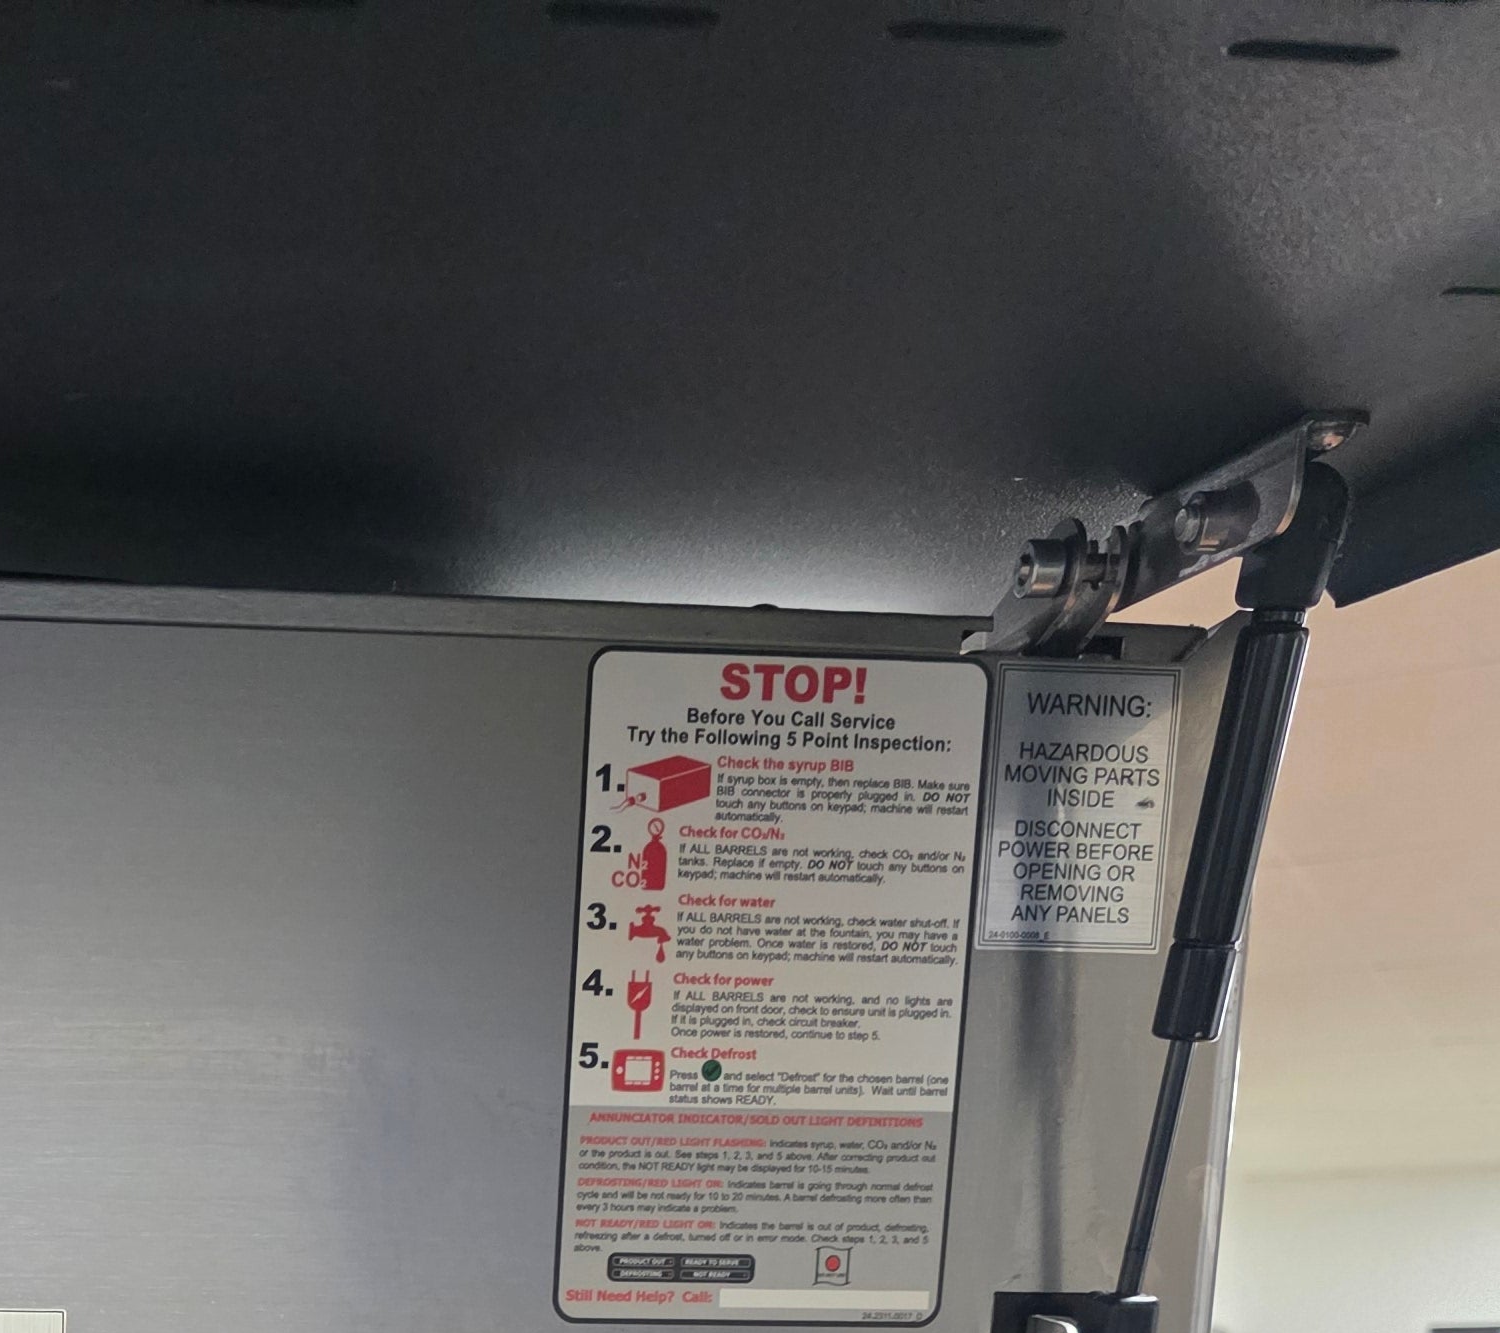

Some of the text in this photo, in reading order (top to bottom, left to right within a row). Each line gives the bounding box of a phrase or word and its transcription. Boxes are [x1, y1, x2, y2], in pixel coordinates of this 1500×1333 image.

[720, 663, 867, 703] STOP!
[1027, 692, 1152, 718] WARNING:
[686, 707, 895, 730] Before You Call Service
[626, 725, 952, 753] Try the Following 5 Point Inspection:
[1019, 742, 1150, 764] HAZARDOUS
[716, 755, 854, 774] Check the syrup BIB
[595, 763, 628, 792] 1.
[1004, 764, 1162, 787] MOVING PARTS
[1046, 787, 1115, 808] INSIDE
[589, 824, 622, 853] 2.
[678, 825, 717, 838] Check
[719, 825, 738, 839] for
[1014, 819, 1143, 839] DISCONNECT
[998, 840, 1154, 861] POWER BEFORE
[1013, 861, 1135, 882] OPENING OR
[677, 893, 775, 908] Check for water
[1020, 883, 1126, 902] REMOVING
[586, 902, 617, 930] 3.
[1010, 904, 1131, 924] ANY PANELS
[581, 968, 613, 996] 4.
[672, 972, 774, 989] Check for power
[578, 1041, 613, 1069] 5.
[670, 1046, 757, 1061] Check Defrost
[566, 1288, 711, 1304] Still Need Help? Call:
